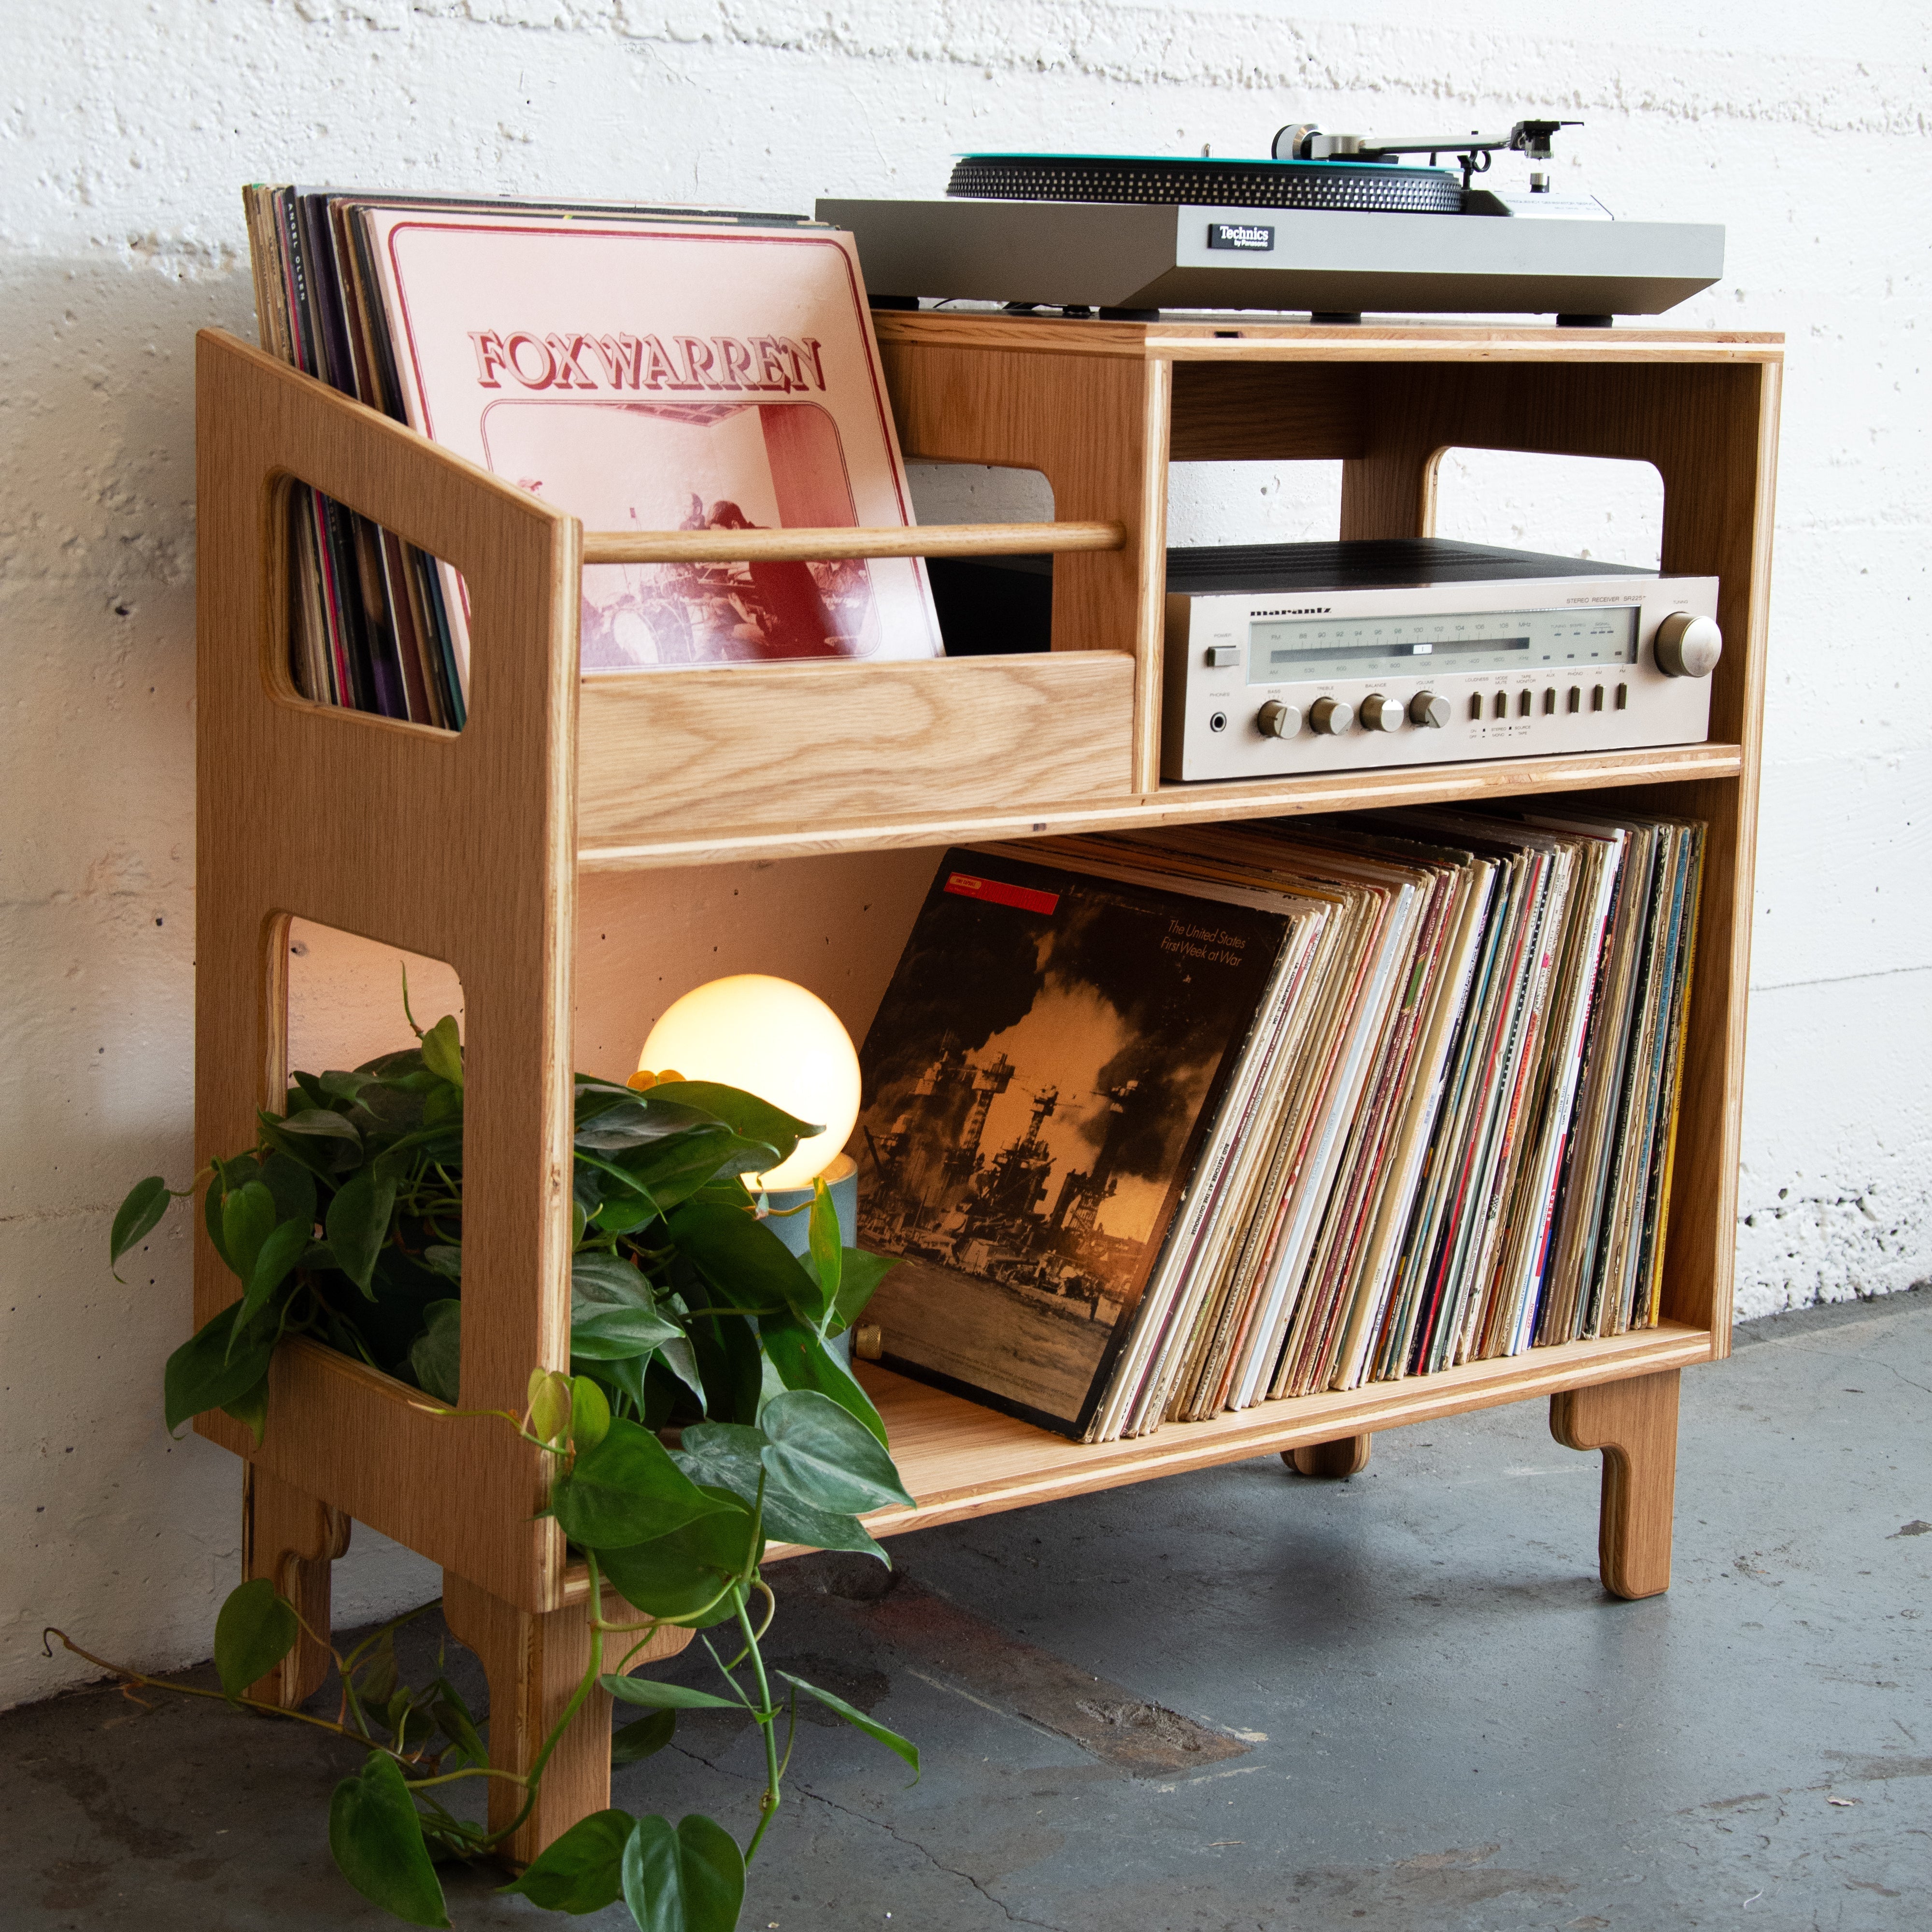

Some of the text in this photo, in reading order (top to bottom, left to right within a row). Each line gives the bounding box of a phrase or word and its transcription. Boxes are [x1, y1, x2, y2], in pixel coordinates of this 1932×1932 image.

[1220, 226, 1268, 241] Technics
[288, 203, 305, 301] ANGEL OLSEN
[467, 329, 826, 394] FOXWARREN
[1250, 608, 1332, 616] marantz
[1559, 893, 1567, 915] ROBERT
[1168, 919, 1246, 949] The United States
[1428, 917, 1436, 933] LITTLE
[1503, 912, 1513, 935] STEVENS
[1161, 937, 1242, 966] First Week at War
[1497, 940, 1506, 958] TEASER
[1517, 891, 1548, 1010] THE KILLS BLOOD
[1588, 933, 1596, 957] REDDING
[1663, 958, 1672, 984] PRESENTS
[1280, 971, 1296, 1004] LOUISIANNE
[1487, 984, 1496, 1005] FIRECAT
[1447, 997, 1455, 1014] HANK
[1456, 988, 1467, 1018] Everything
[1398, 1016, 1407, 1037] WAITING
[1438, 1016, 1450, 1045] WILLIAMS
[1386, 1050, 1397, 1078] COLUMBUS
[1432, 1051, 1441, 1067] HANK
[1677, 1043, 1686, 1089] THELONIOUS
[1252, 1088, 1264, 1111] ORANGE
[1242, 1113, 1255, 1138] BLOSSOM
[1222, 1143, 1230, 1154] BUD
[1234, 1140, 1245, 1161] SPECIAL
[1409, 1130, 1420, 1150] Legend
[1305, 1112, 1336, 1195] ALABAMA SHAKES BOYS GIRLS
[1211, 1156, 1224, 1181] FLETCHER
[1403, 1160, 1411, 1174] Hank
[1221, 1176, 1232, 1196] WHEELS
[1350, 1171, 1362, 1196] DUPLICATION
[1395, 1176, 1406, 1199] Williams
[1341, 1206, 1351, 1227] VIOLATION
[1389, 1209, 1398, 1223] Song
[1546, 1189, 1556, 1222] LONER
[1190, 1205, 1206, 1236] OUTHOUSE
[1215, 1109, 1300, 1349] GAITE PARISIENNE HOLLYWOOD BOWL SYMPHONY ORCHESTRA
[1231, 1228, 1249, 1269] INVISIBLE TEARS
[1332, 1234, 1343, 1259] APPLICABLE
[1381, 1237, 1390, 1250] Story
[1468, 1252, 1477, 1275] RECORDS
[1518, 1275, 1528, 1304] SUNDAZED
[1525, 1303, 1534, 1328] NW5229
[1346, 1334, 1364, 1381] MGM RECORDS
[1148, 1350, 1168, 1392] STEREOPHONIC
